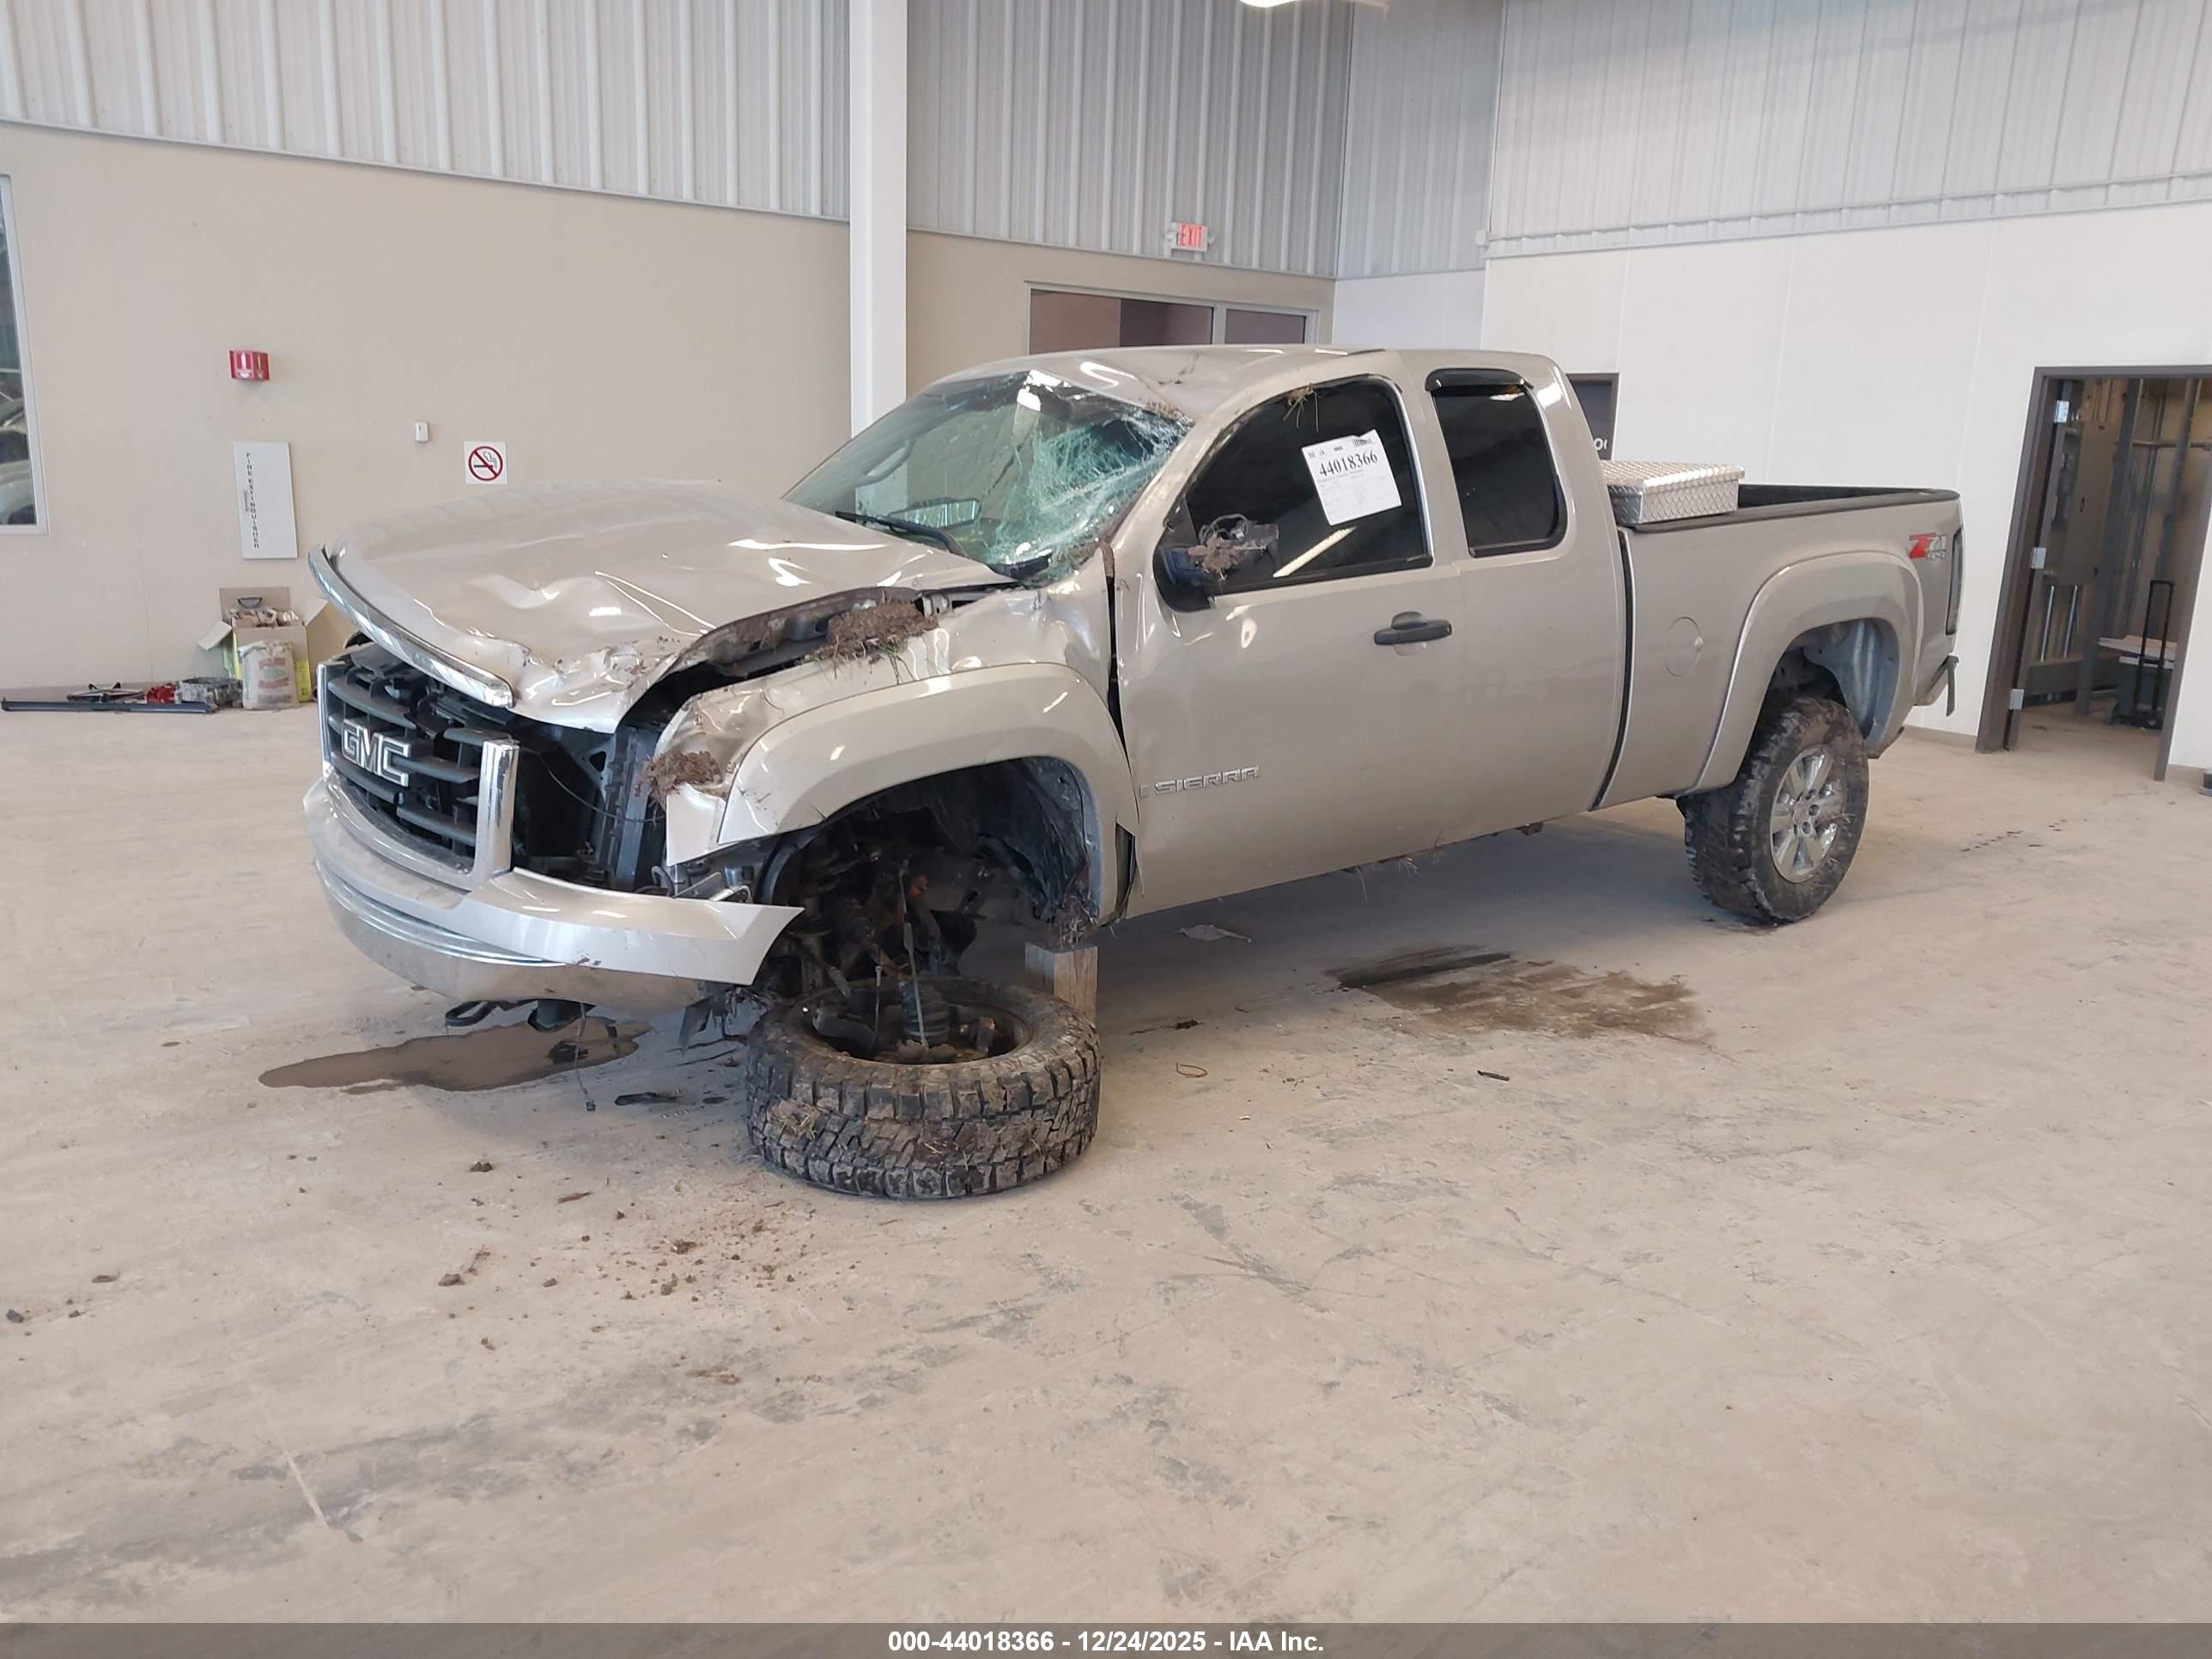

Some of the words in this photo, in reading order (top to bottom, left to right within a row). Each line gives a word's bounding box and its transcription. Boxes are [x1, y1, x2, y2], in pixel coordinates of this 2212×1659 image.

[1181, 223, 1203, 247] EXIT
[1320, 450, 1378, 477] 44018366
[342, 719, 410, 787] GMC
[1155, 766, 1259, 794] SIERRA
